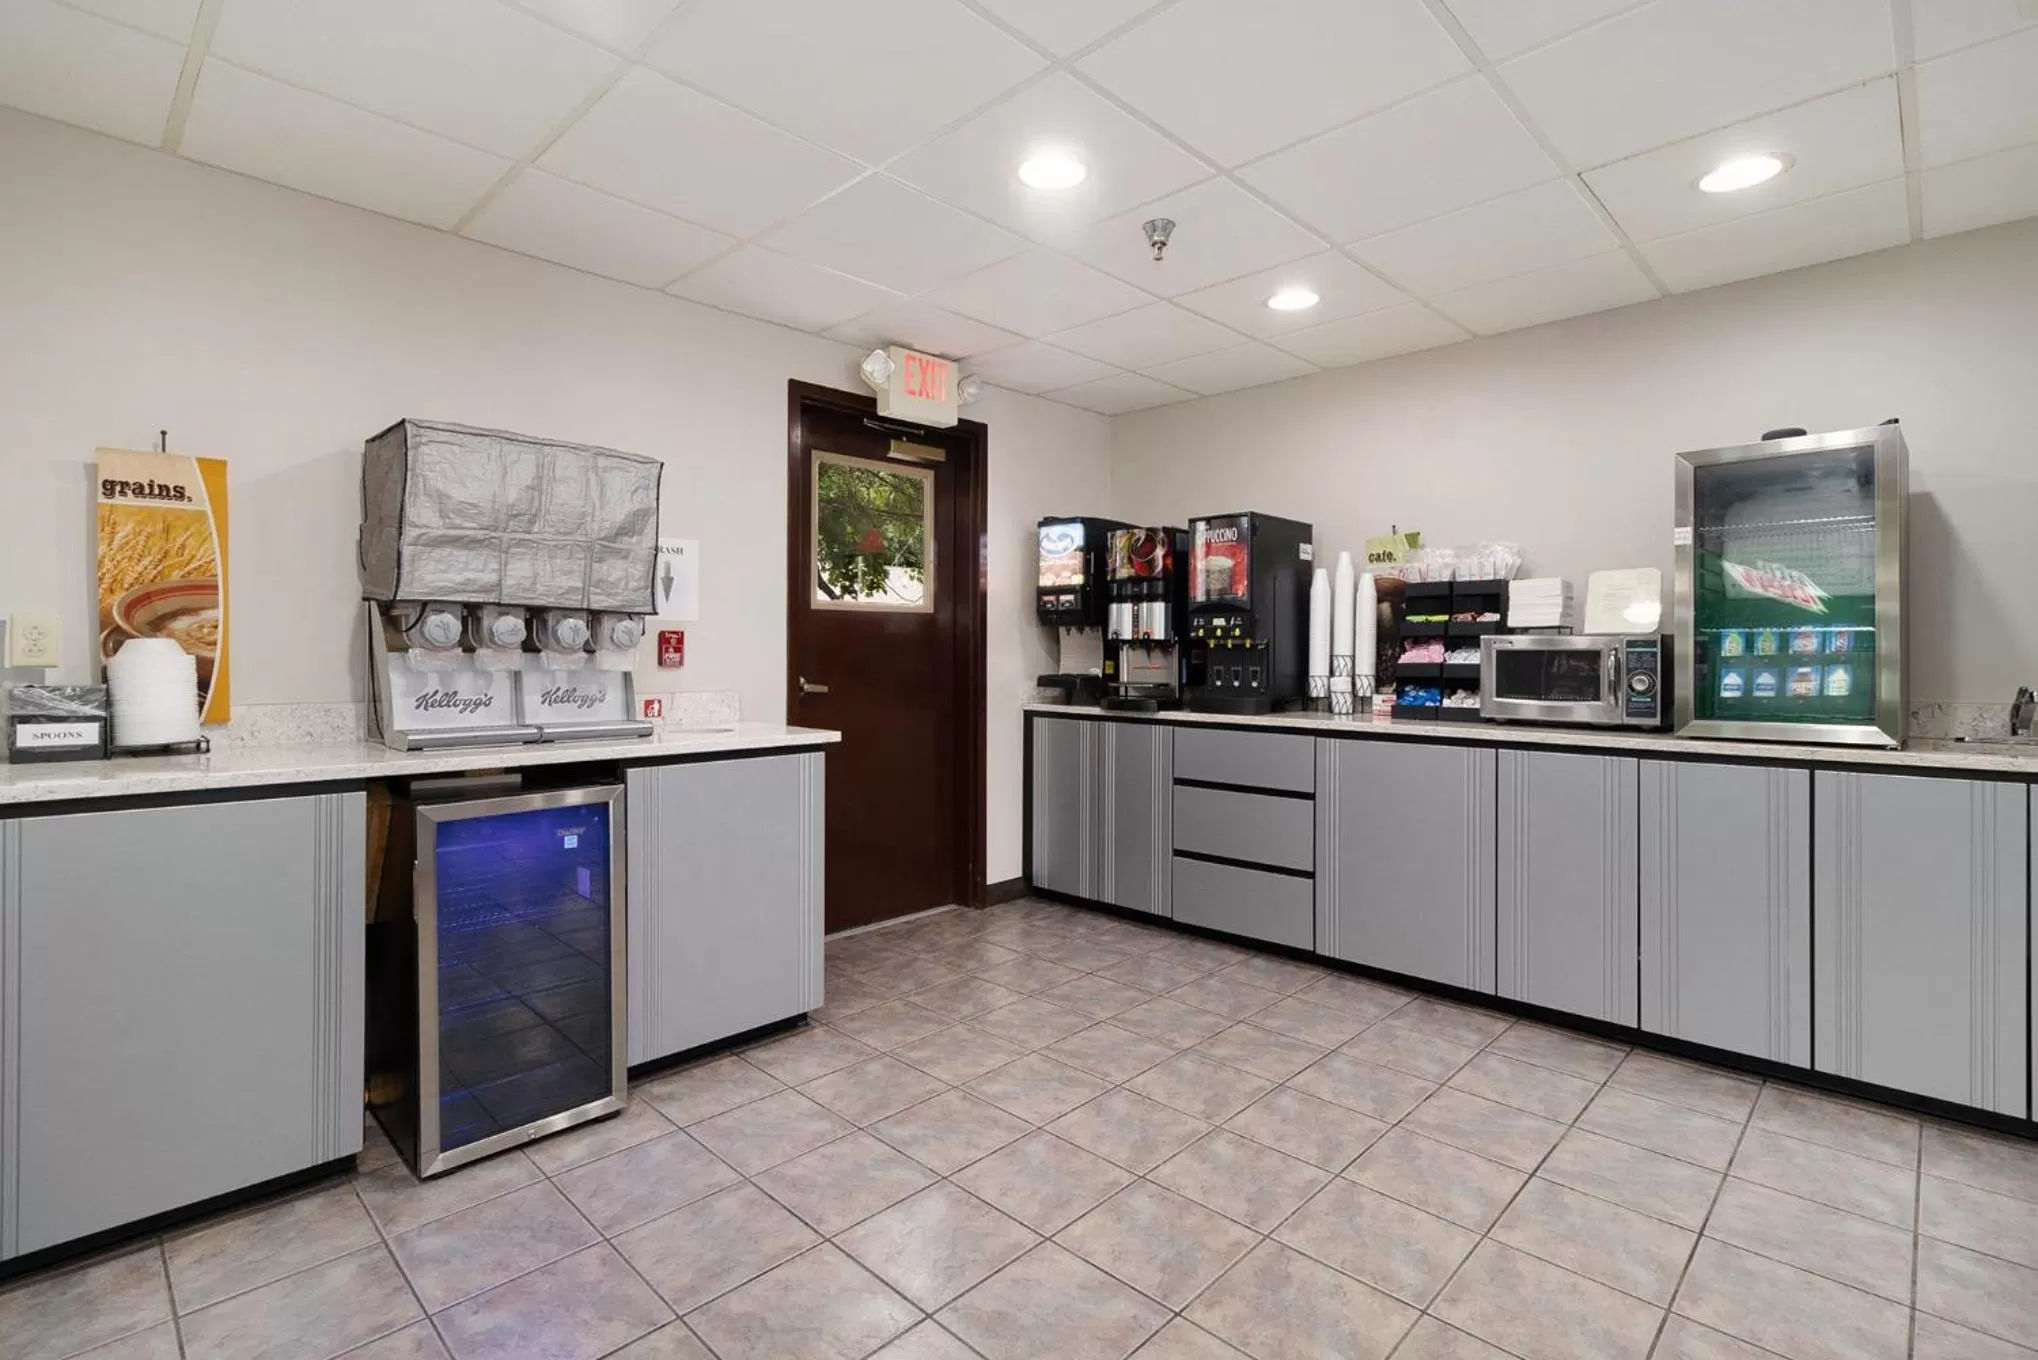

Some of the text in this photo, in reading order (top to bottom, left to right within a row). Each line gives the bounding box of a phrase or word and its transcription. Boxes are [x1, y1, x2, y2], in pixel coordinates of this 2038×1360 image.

[904, 353, 951, 404] EXIT
[101, 479, 193, 502] grains.
[658, 545, 684, 556] RASH
[415, 689, 494, 714] Kellogg's
[540, 686, 607, 709] Kellogg's
[32, 731, 84, 740] SPOONS
